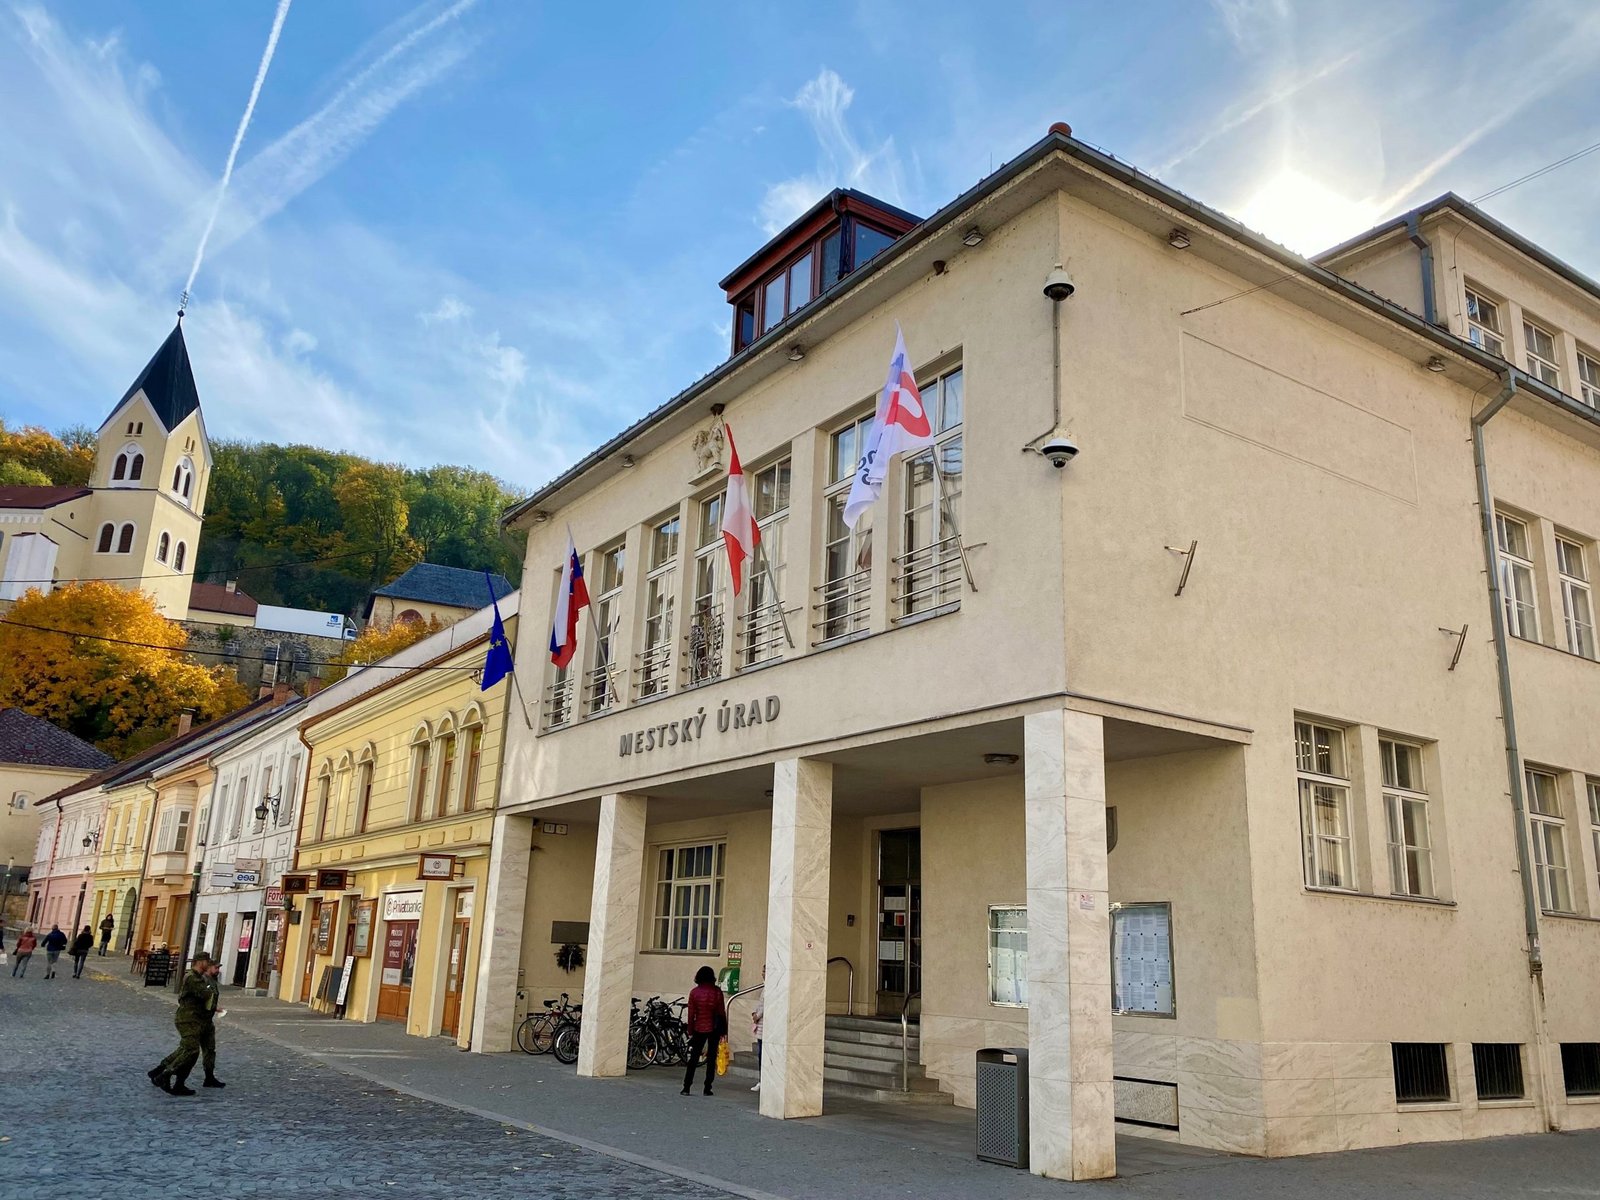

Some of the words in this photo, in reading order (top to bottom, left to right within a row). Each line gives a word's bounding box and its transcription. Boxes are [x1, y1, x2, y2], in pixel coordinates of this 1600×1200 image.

[619, 706, 707, 757] MESTSKÝ
[717, 695, 780, 733] ÚRAD
[267, 892, 284, 901] FOTO
